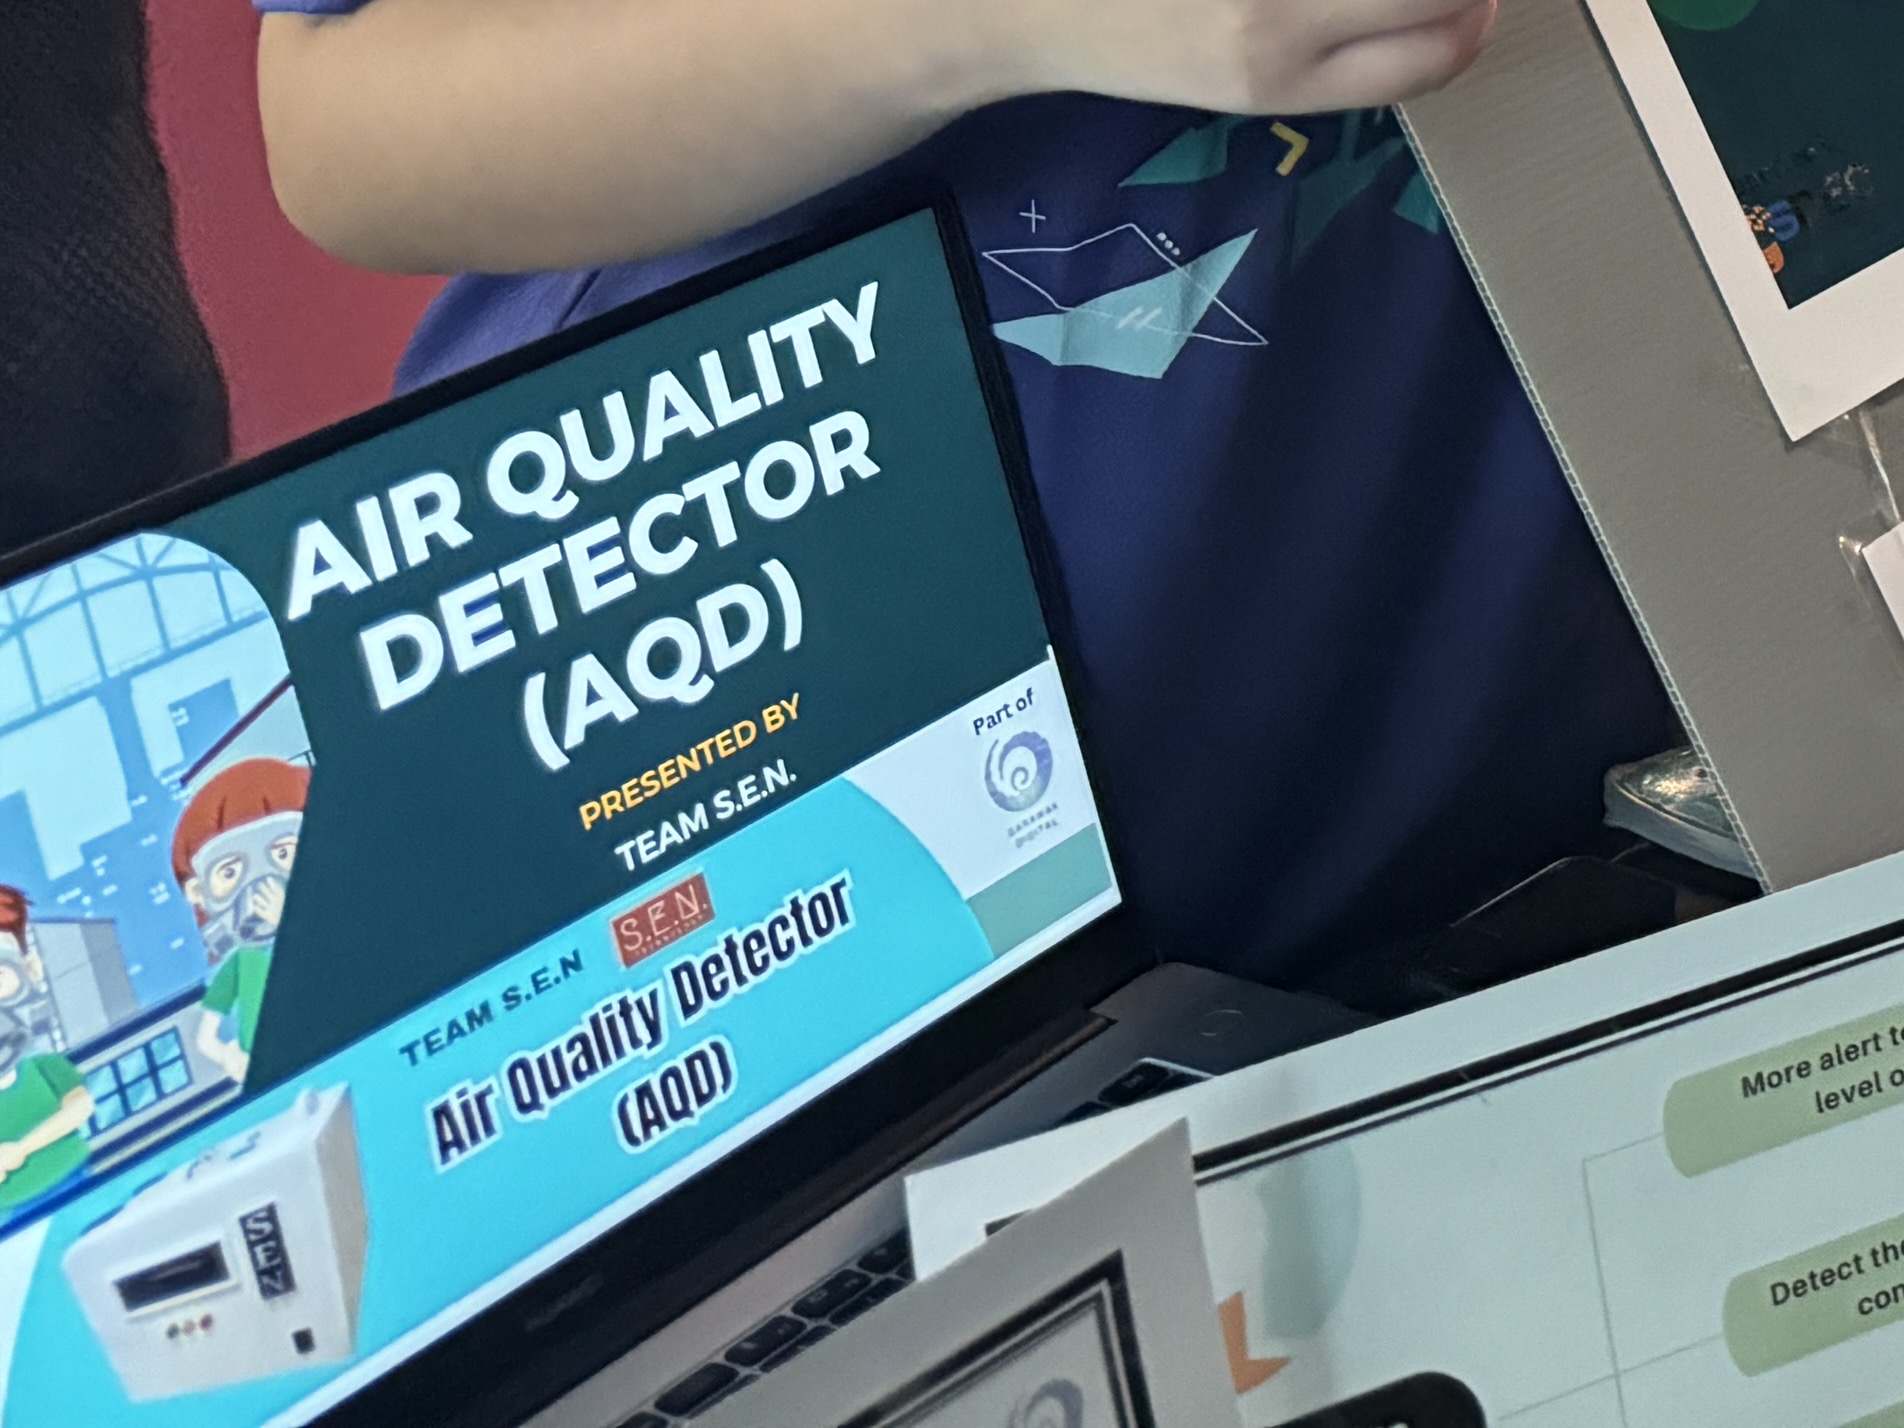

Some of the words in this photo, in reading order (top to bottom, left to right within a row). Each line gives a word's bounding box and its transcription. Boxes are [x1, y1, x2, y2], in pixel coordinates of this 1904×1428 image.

[287, 470, 474, 623] AIR
[486, 280, 880, 521] QUALITY
[358, 409, 882, 713] DETECTOR
[522, 558, 804, 772] (AQD)
[972, 703, 1014, 736] Part
[1015, 687, 1034, 713] of
[578, 719, 758, 832] PRESENTED
[761, 691, 800, 734] BY
[613, 802, 710, 872] TEAM
[712, 757, 798, 821] S.E.N.
[620, 884, 708, 952] S.E.N.
[398, 1000, 496, 1067] TEAM
[499, 948, 586, 1013] S.E.N
[430, 1080, 500, 1167] Air
[506, 986, 662, 1115] Quality
[669, 875, 852, 1022] Detector
[1740, 1057, 1812, 1099] More
[1819, 1031, 1884, 1072] alert
[616, 1039, 734, 1148] (AQD)
[1814, 1071, 1884, 1114] level
[1769, 1251, 1865, 1307] Detect
